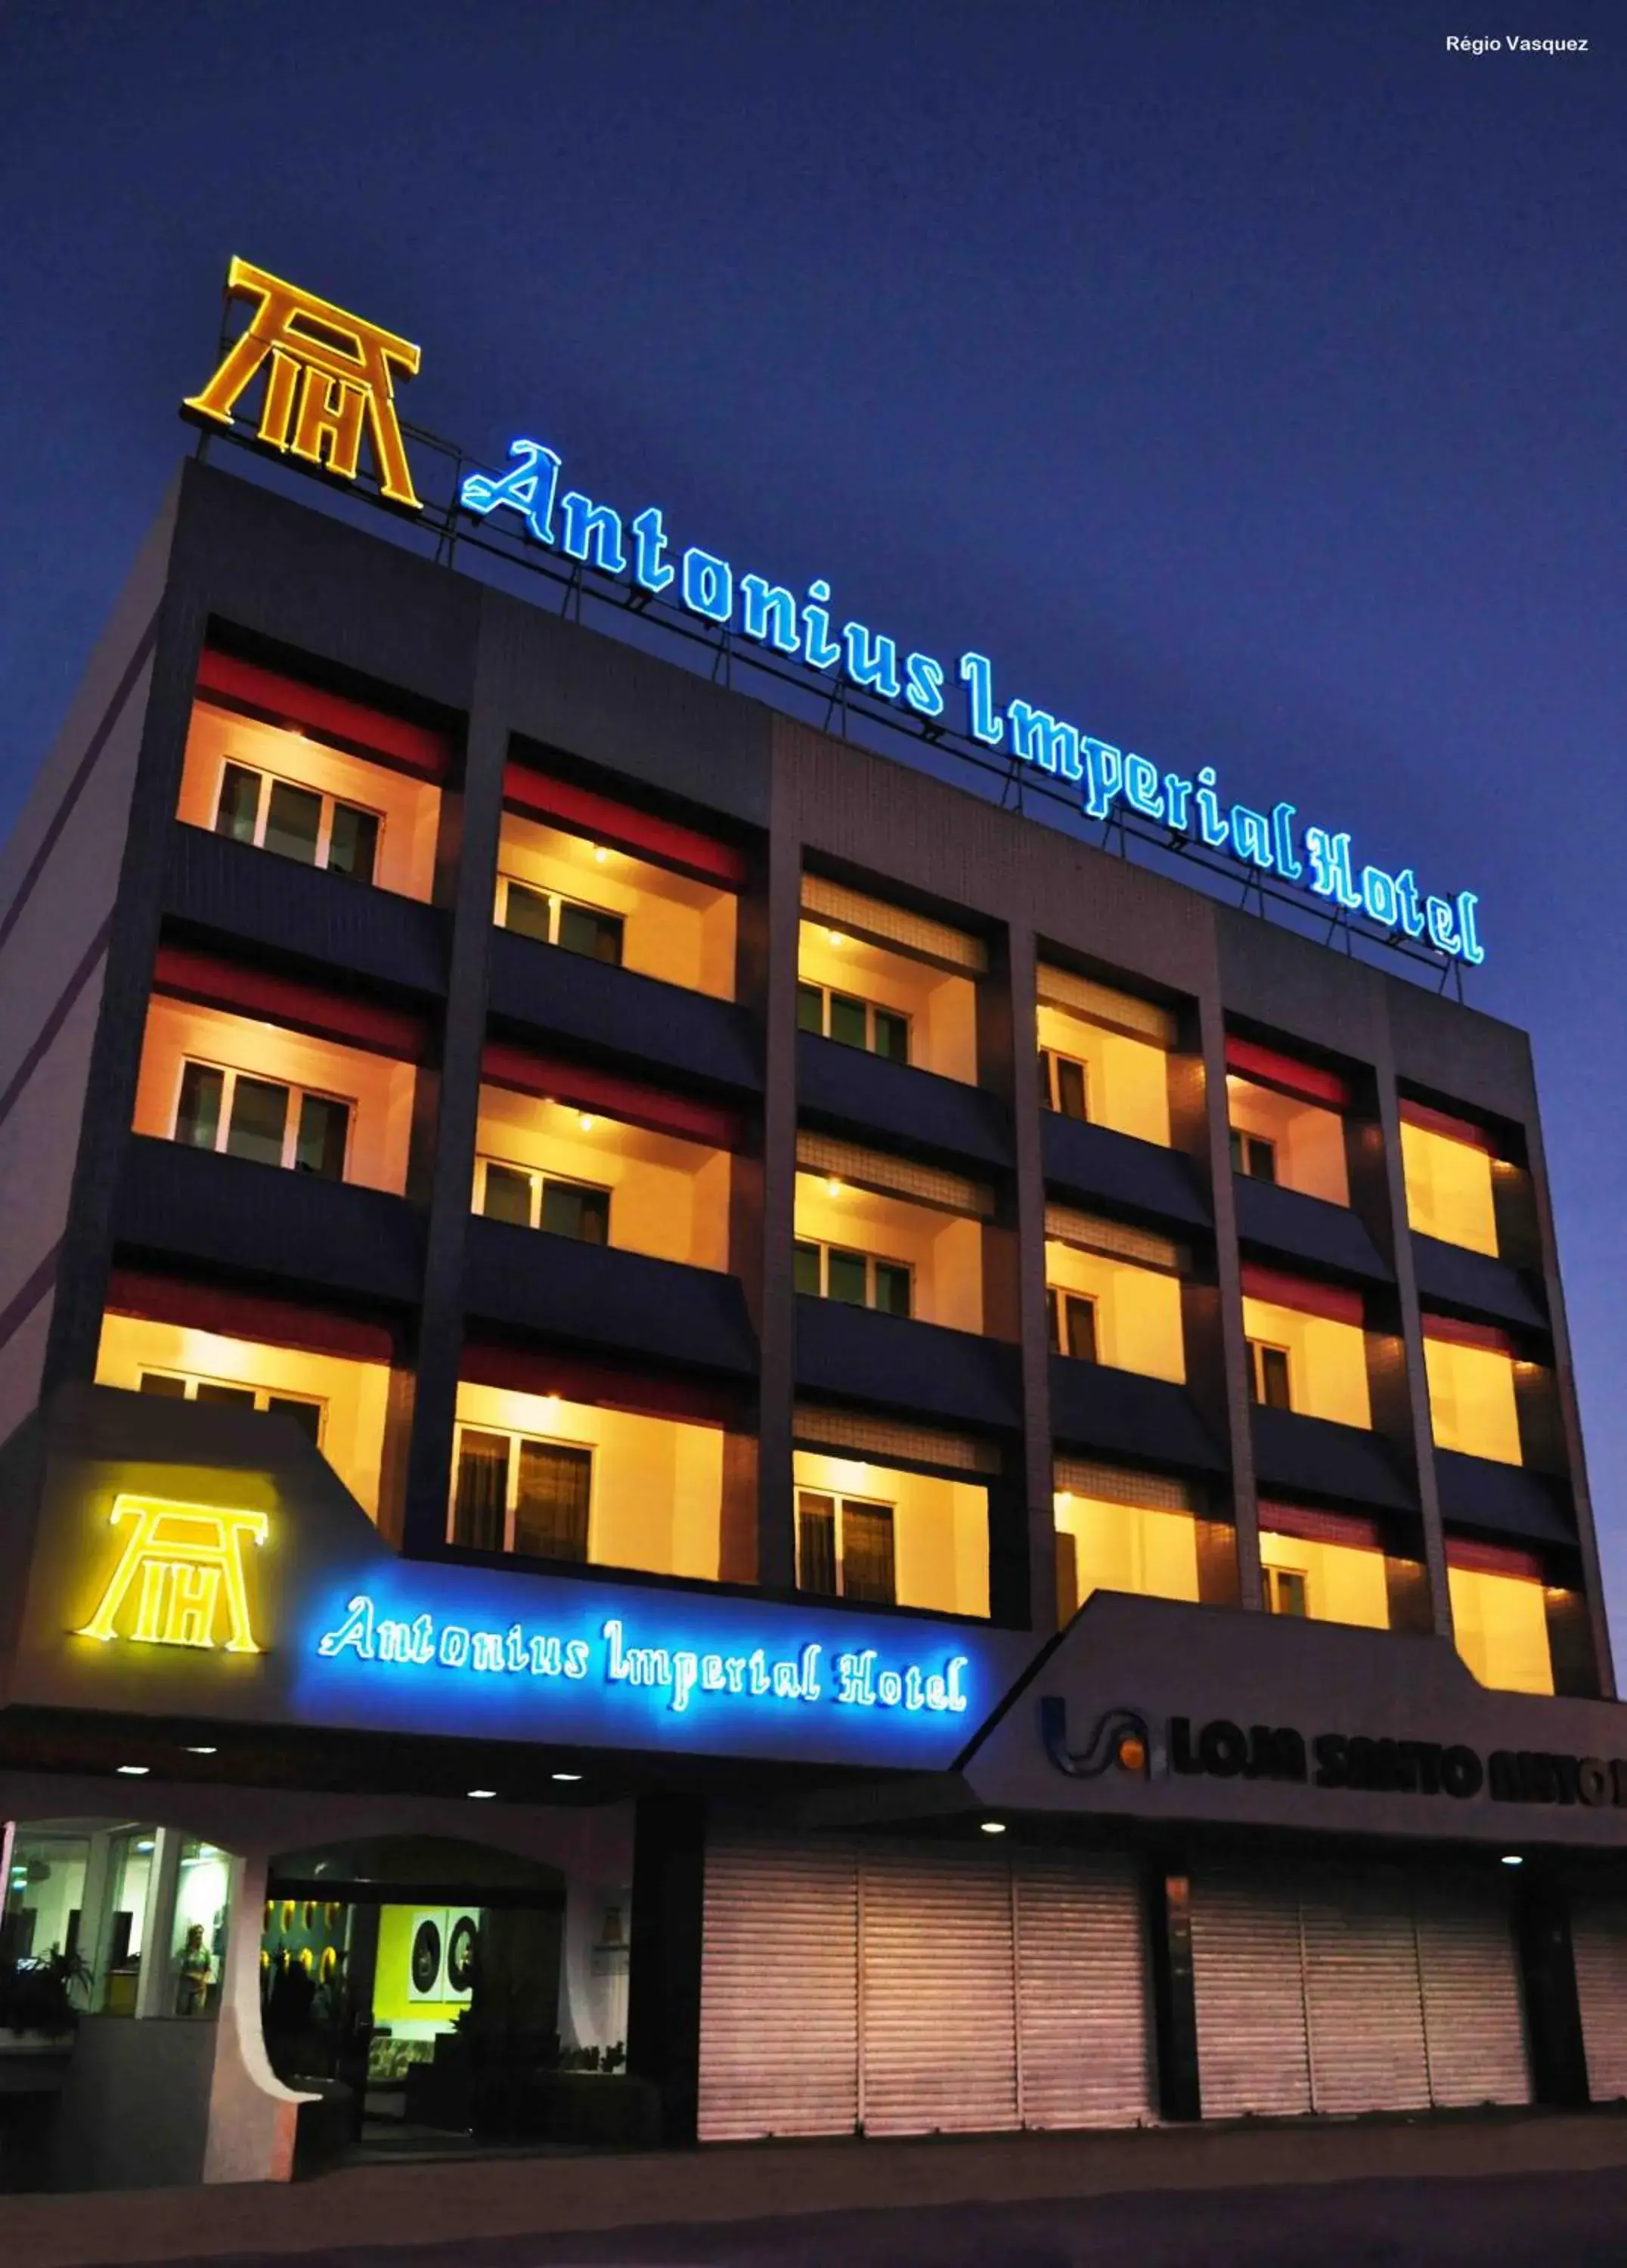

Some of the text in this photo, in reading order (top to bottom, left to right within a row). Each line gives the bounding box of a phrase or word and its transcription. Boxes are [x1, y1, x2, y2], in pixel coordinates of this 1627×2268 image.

[460, 436, 1486, 966] Antonius Imperial Hotel
[318, 1594, 969, 1713] Antonius Imperial Hotel
